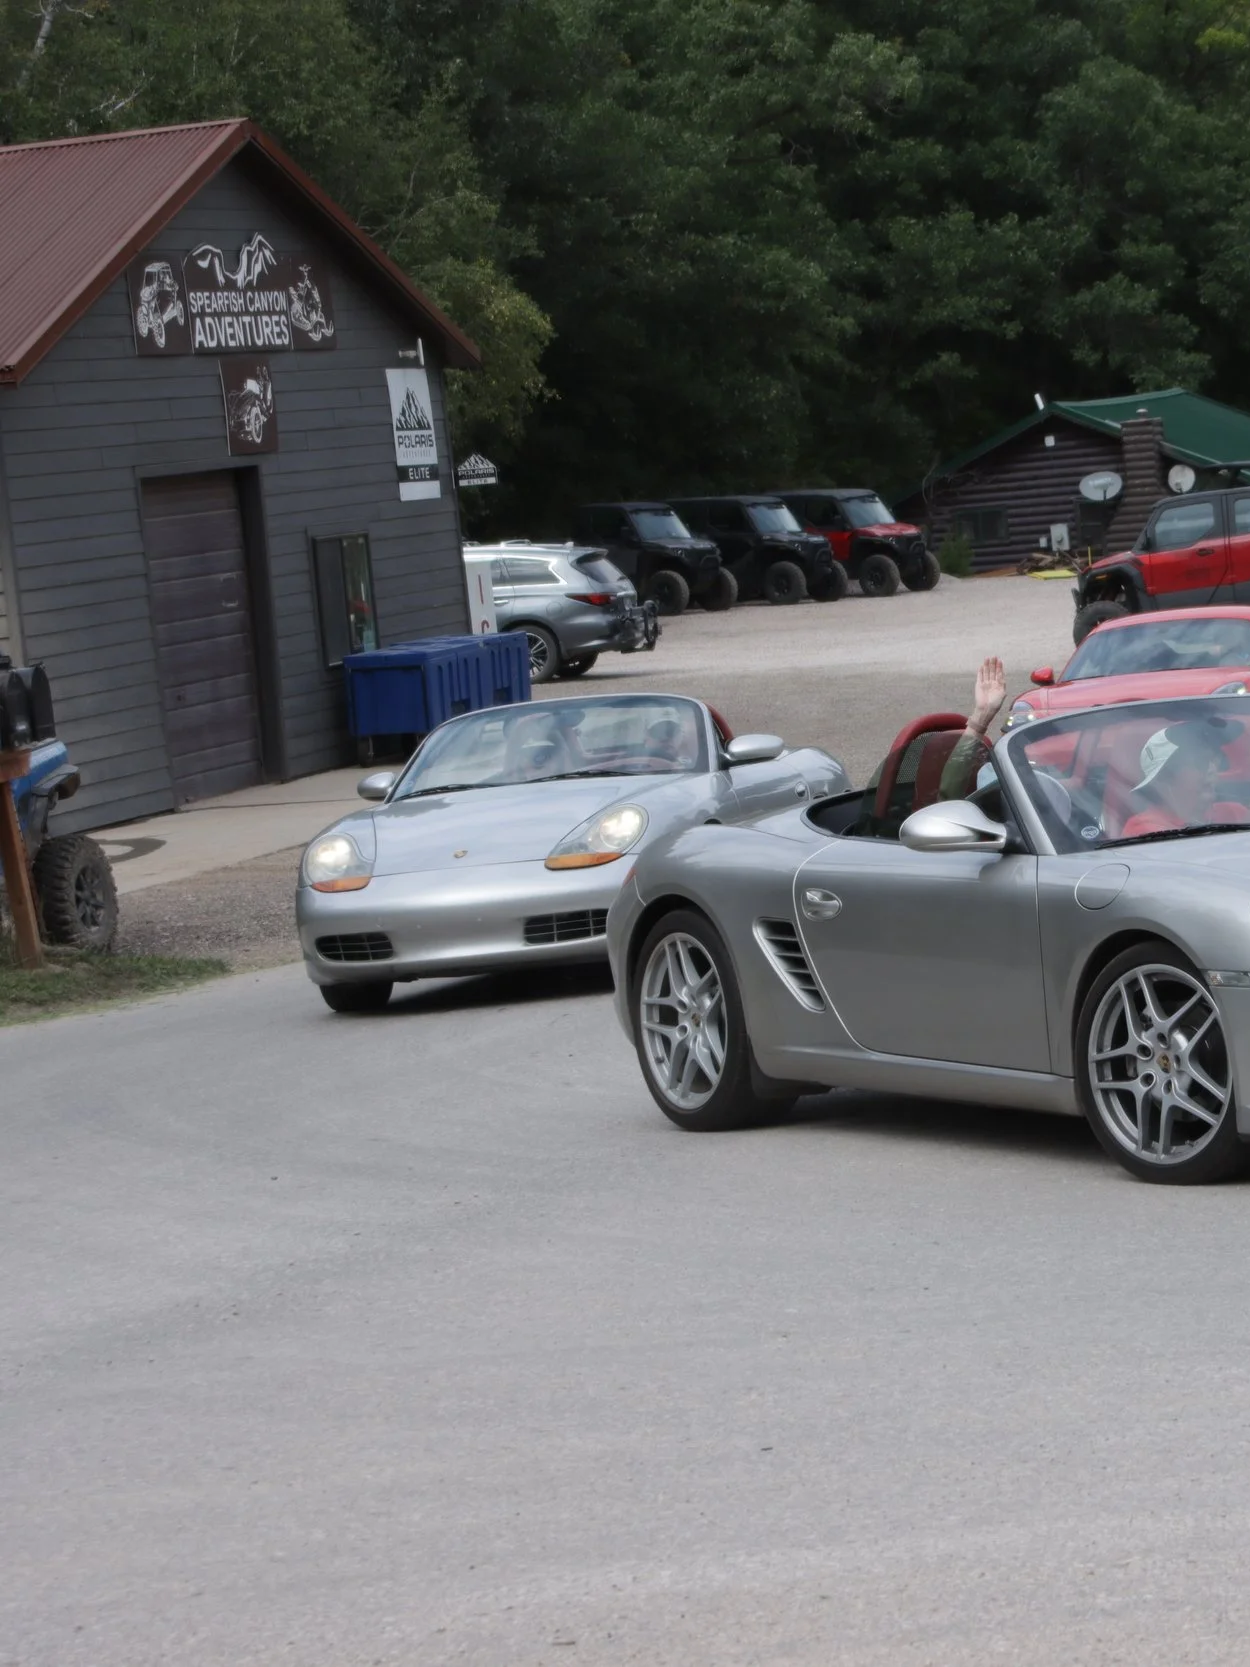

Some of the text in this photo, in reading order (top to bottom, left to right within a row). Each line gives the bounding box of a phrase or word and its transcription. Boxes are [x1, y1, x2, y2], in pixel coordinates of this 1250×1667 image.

[189, 290, 287, 313] SPEARFISH CANYON
[195, 314, 290, 348] ADVENTURES
[397, 434, 434, 449] POLARIS
[408, 467, 430, 480] ELITE
[458, 468, 495, 476] POLARIS
